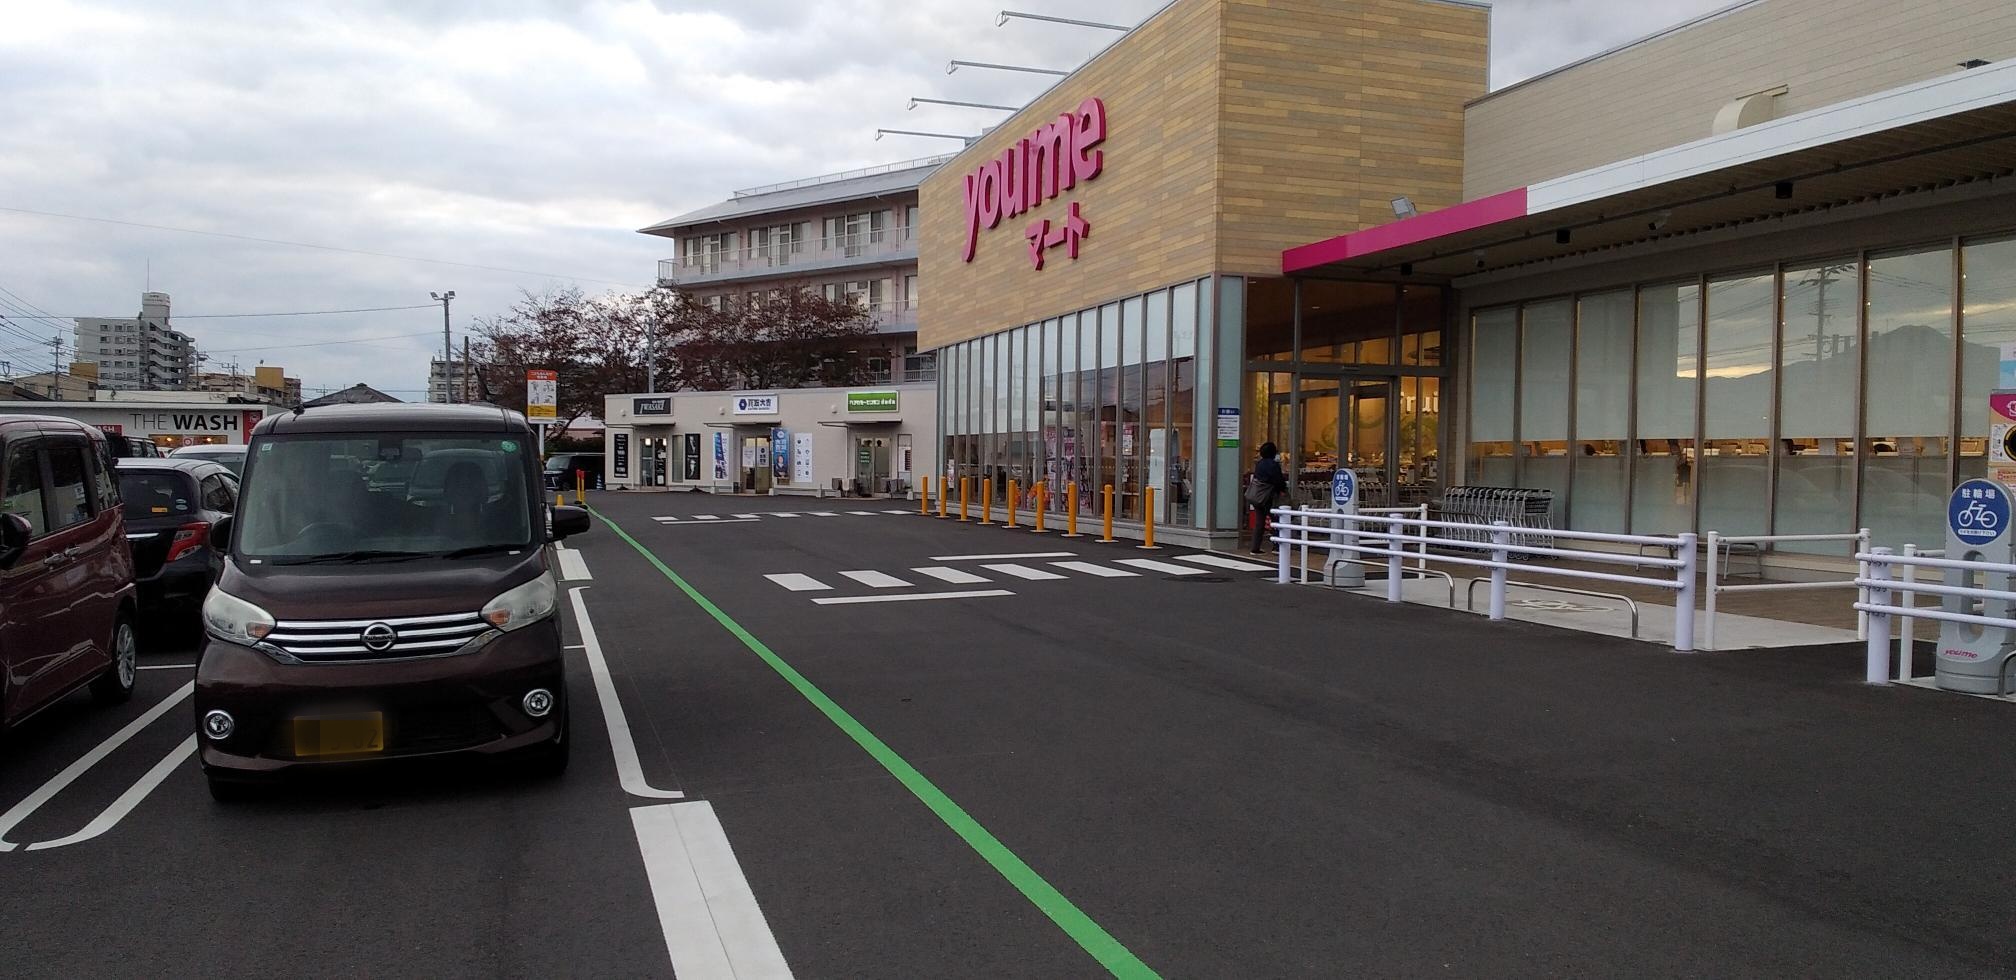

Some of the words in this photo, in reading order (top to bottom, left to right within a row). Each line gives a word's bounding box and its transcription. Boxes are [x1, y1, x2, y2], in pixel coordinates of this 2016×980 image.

[962, 96, 1106, 262] youme
[1025, 202, 1090, 271] マート
[95, 425, 115, 433] ASH
[129, 413, 168, 430] THE
[172, 414, 238, 431] WASH
